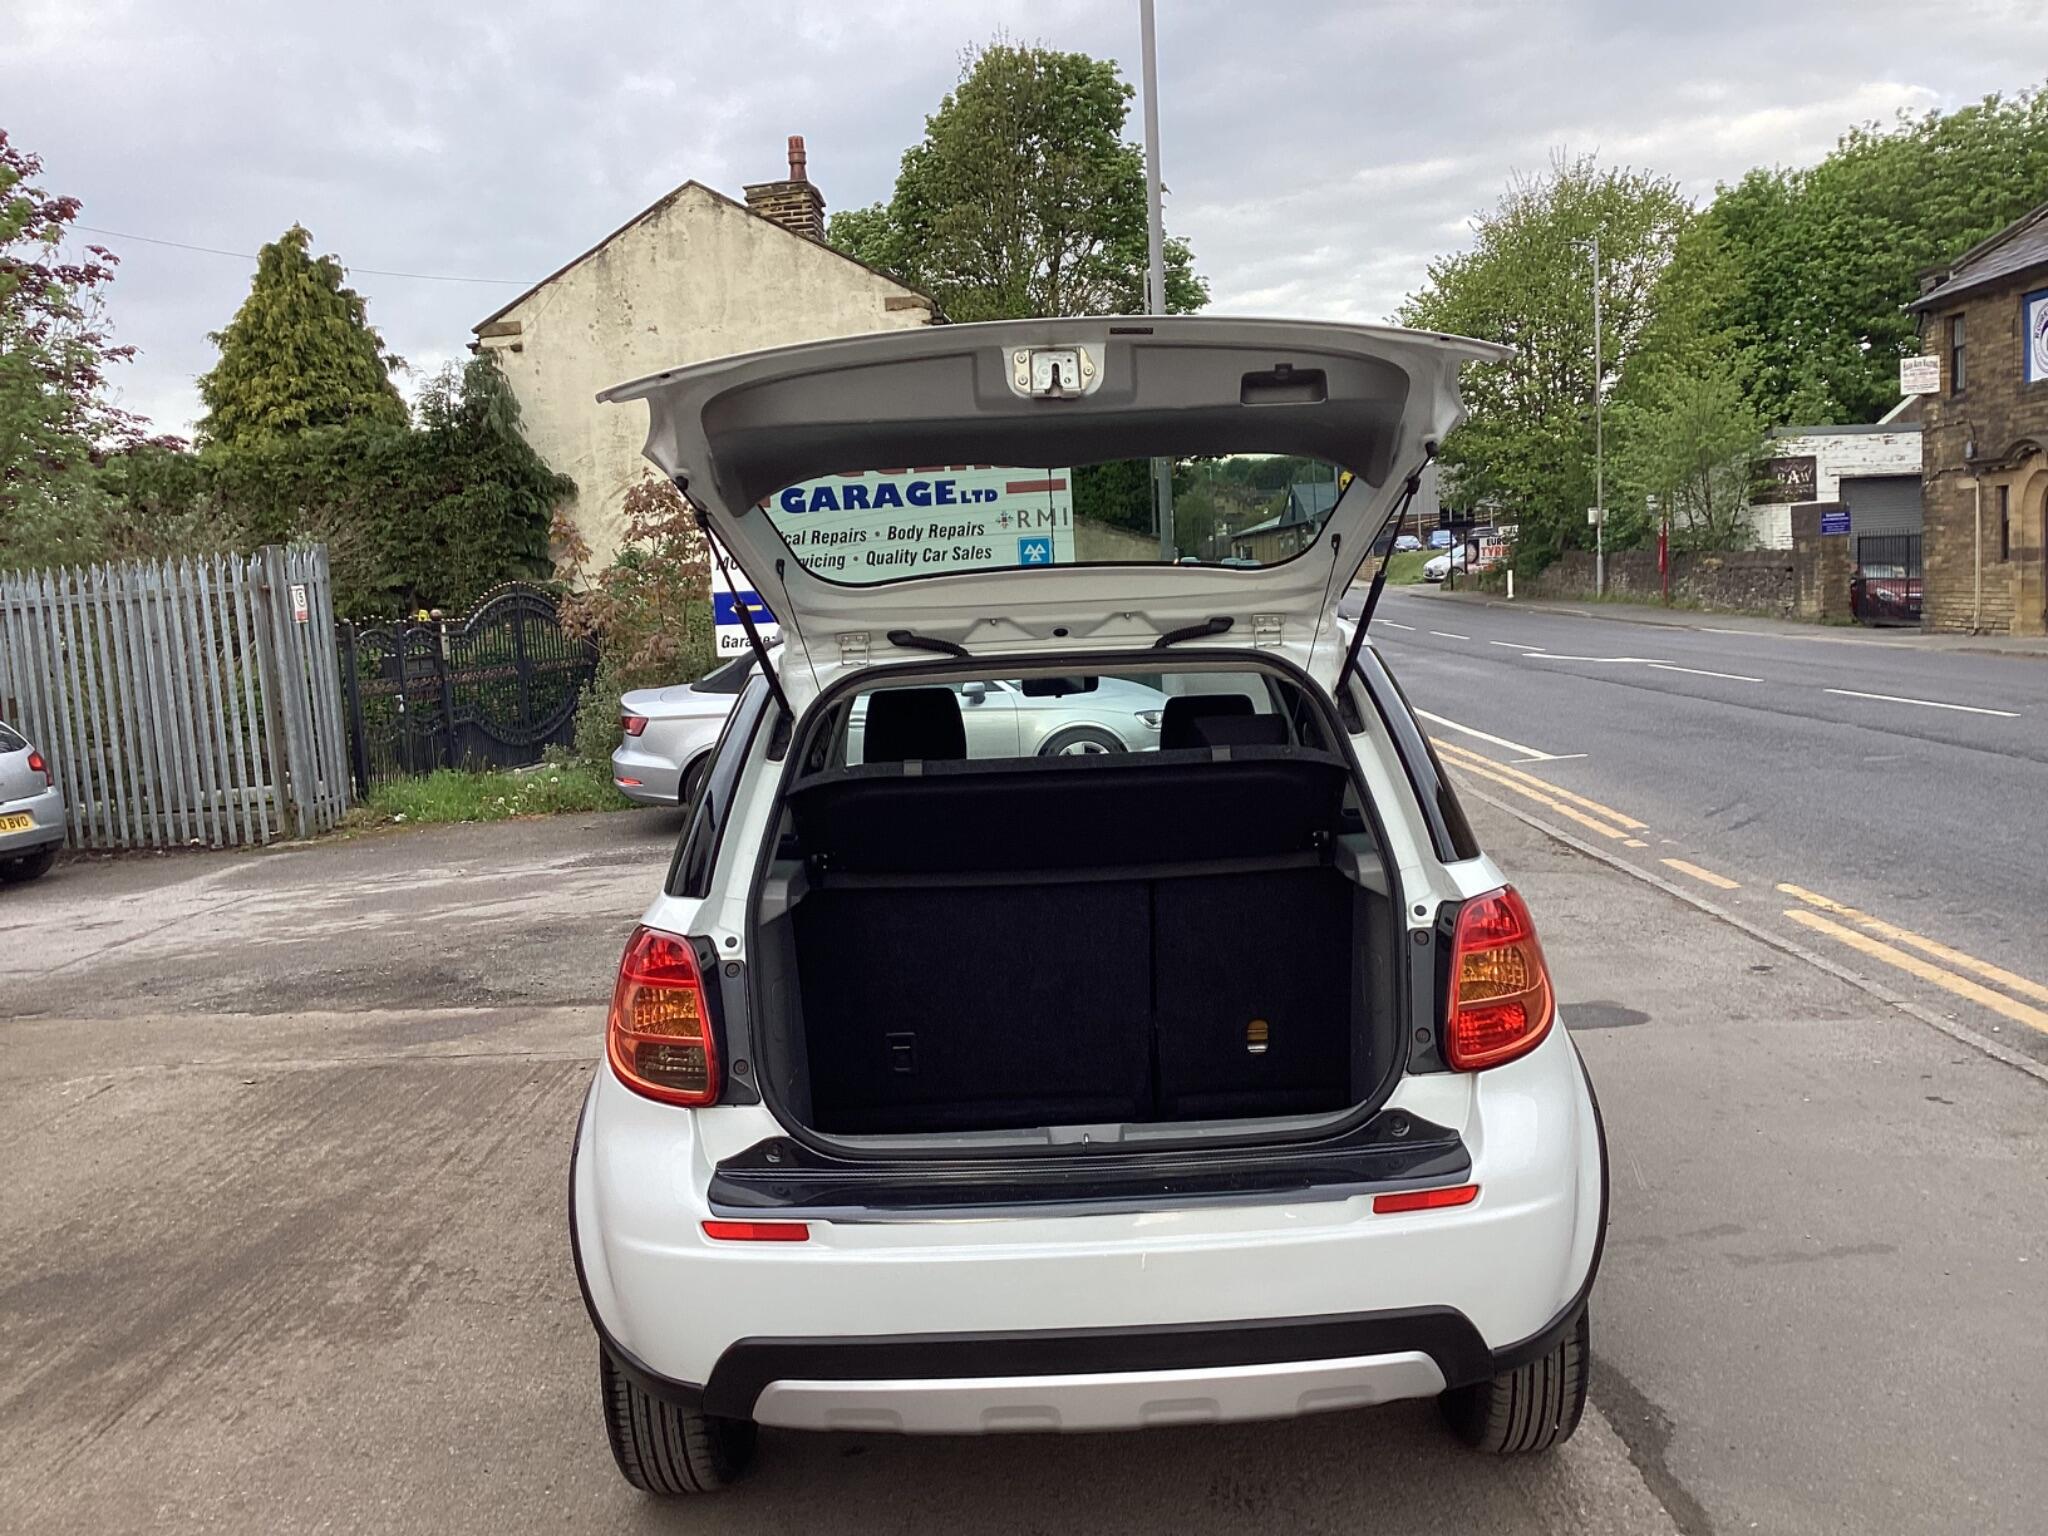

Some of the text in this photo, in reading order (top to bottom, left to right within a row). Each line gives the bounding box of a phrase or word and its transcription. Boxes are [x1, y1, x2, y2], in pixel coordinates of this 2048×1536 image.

[780, 480, 998, 514] GARAGE LTD
[1017, 507, 1068, 529] RMI
[811, 527, 867, 547] Repairs
[887, 524, 923, 542] Body
[928, 521, 985, 540] Repairs
[800, 545, 993, 571] vicing Quality Car Sales
